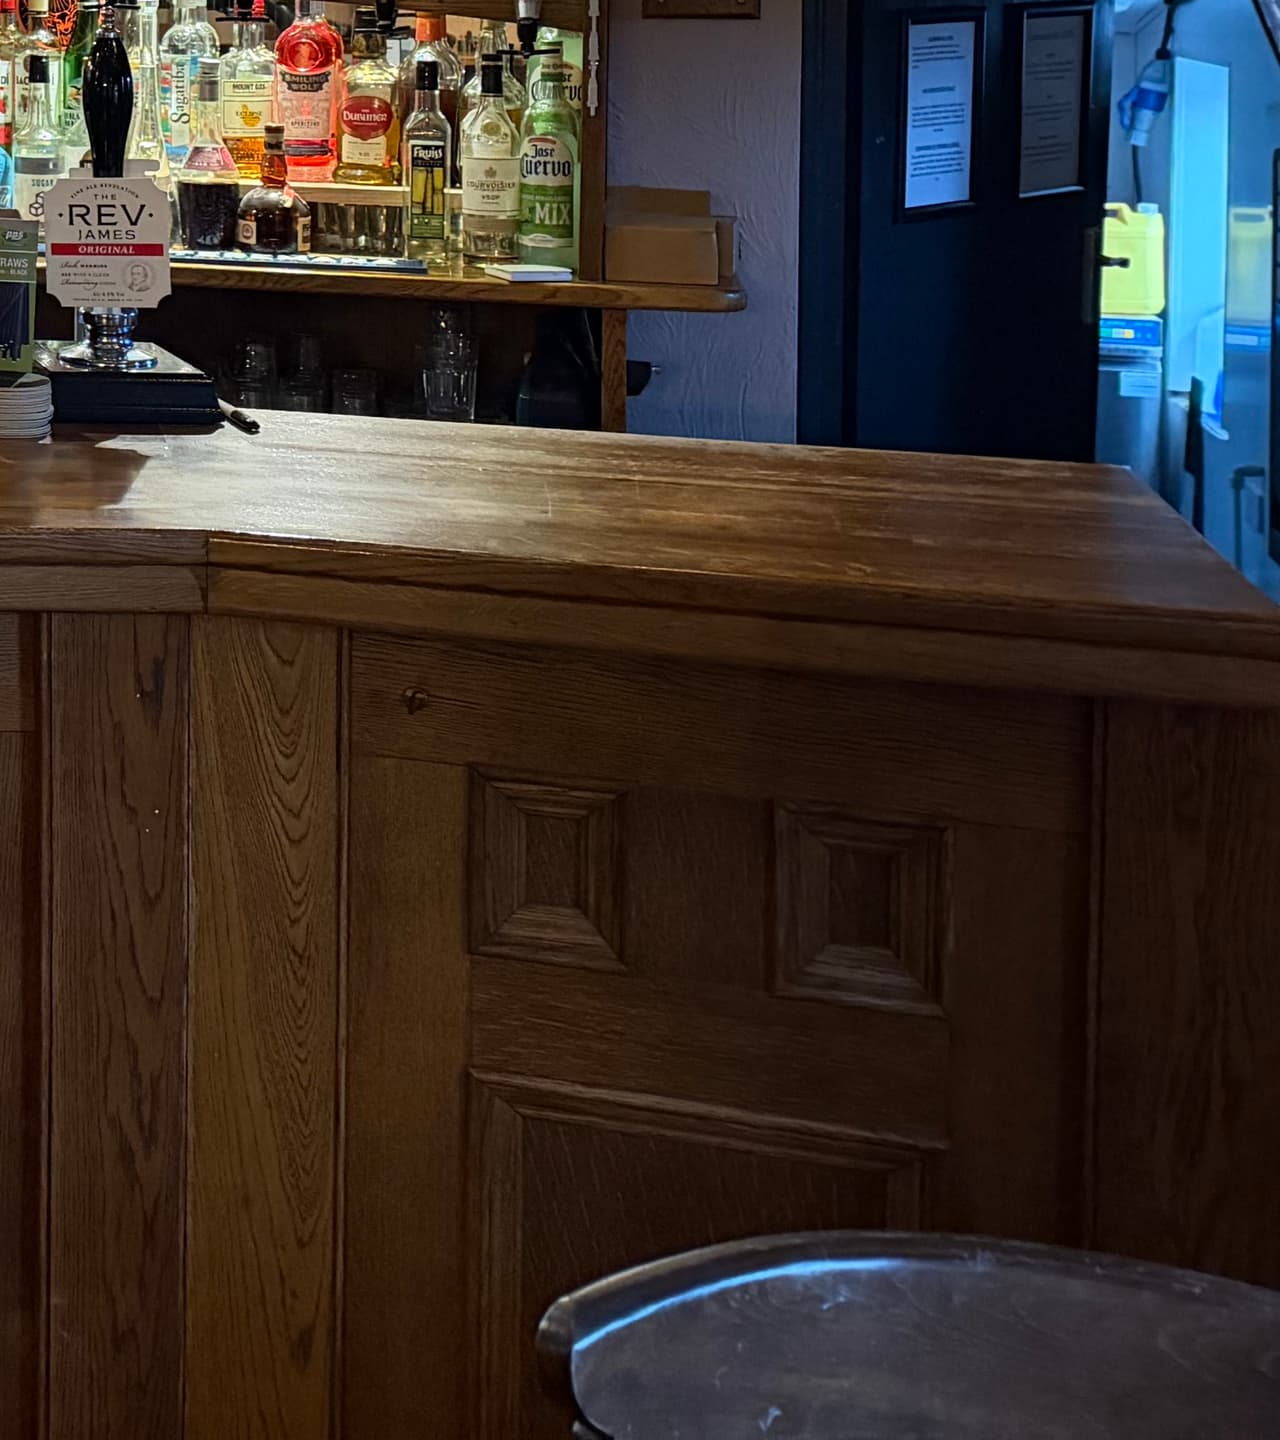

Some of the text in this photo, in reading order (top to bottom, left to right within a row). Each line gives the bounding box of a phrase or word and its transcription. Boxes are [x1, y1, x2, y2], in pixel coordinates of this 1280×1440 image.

[284, 74, 328, 83] SMILING
[291, 83, 321, 92] WOLF
[520, 154, 571, 179] Cuervo
[466, 179, 517, 191] COURVOISIER
[93, 193, 117, 201] THE
[481, 193, 501, 202] VSOP
[68, 204, 147, 226] REV
[535, 202, 571, 225] MIX
[78, 229, 137, 241] JAMES
[78, 245, 136, 255] ORIGINAL
